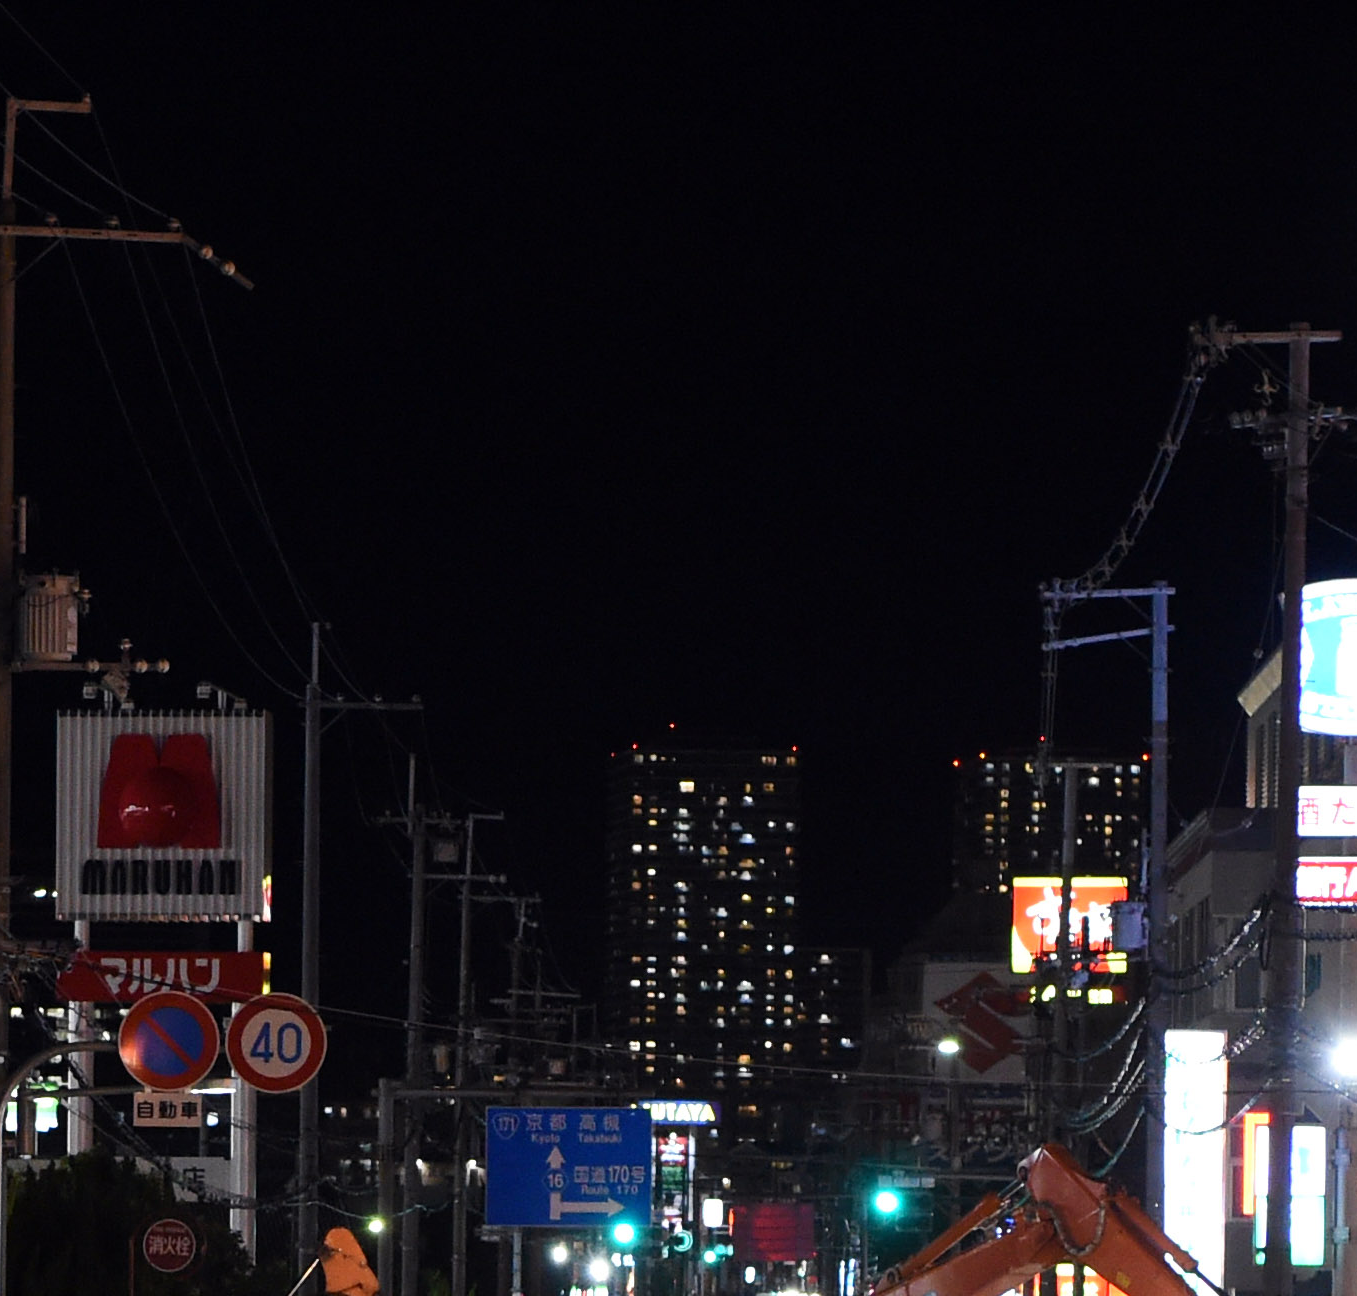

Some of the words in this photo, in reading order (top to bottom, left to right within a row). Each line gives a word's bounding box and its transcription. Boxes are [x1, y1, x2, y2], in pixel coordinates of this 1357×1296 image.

[82, 860, 239, 895] MARUHAN
[100, 957, 220, 994] マルハン
[250, 1022, 303, 1064] 40
[137, 1101, 199, 1119] 自動車
[631, 1103, 716, 1122] UTAYA
[498, 1116, 517, 1132] 171
[526, 1114, 567, 1131] 京都
[579, 1114, 620, 1131] 高槻
[531, 1134, 560, 1145] Kyoto
[578, 1134, 622, 1144] Takatsuki
[548, 1173, 564, 1188] 16
[574, 1165, 645, 1184] 国道170号
[581, 1186, 609, 1196] Route
[616, 1186, 639, 1195] 170
[149, 1235, 191, 1256] 消火栓
